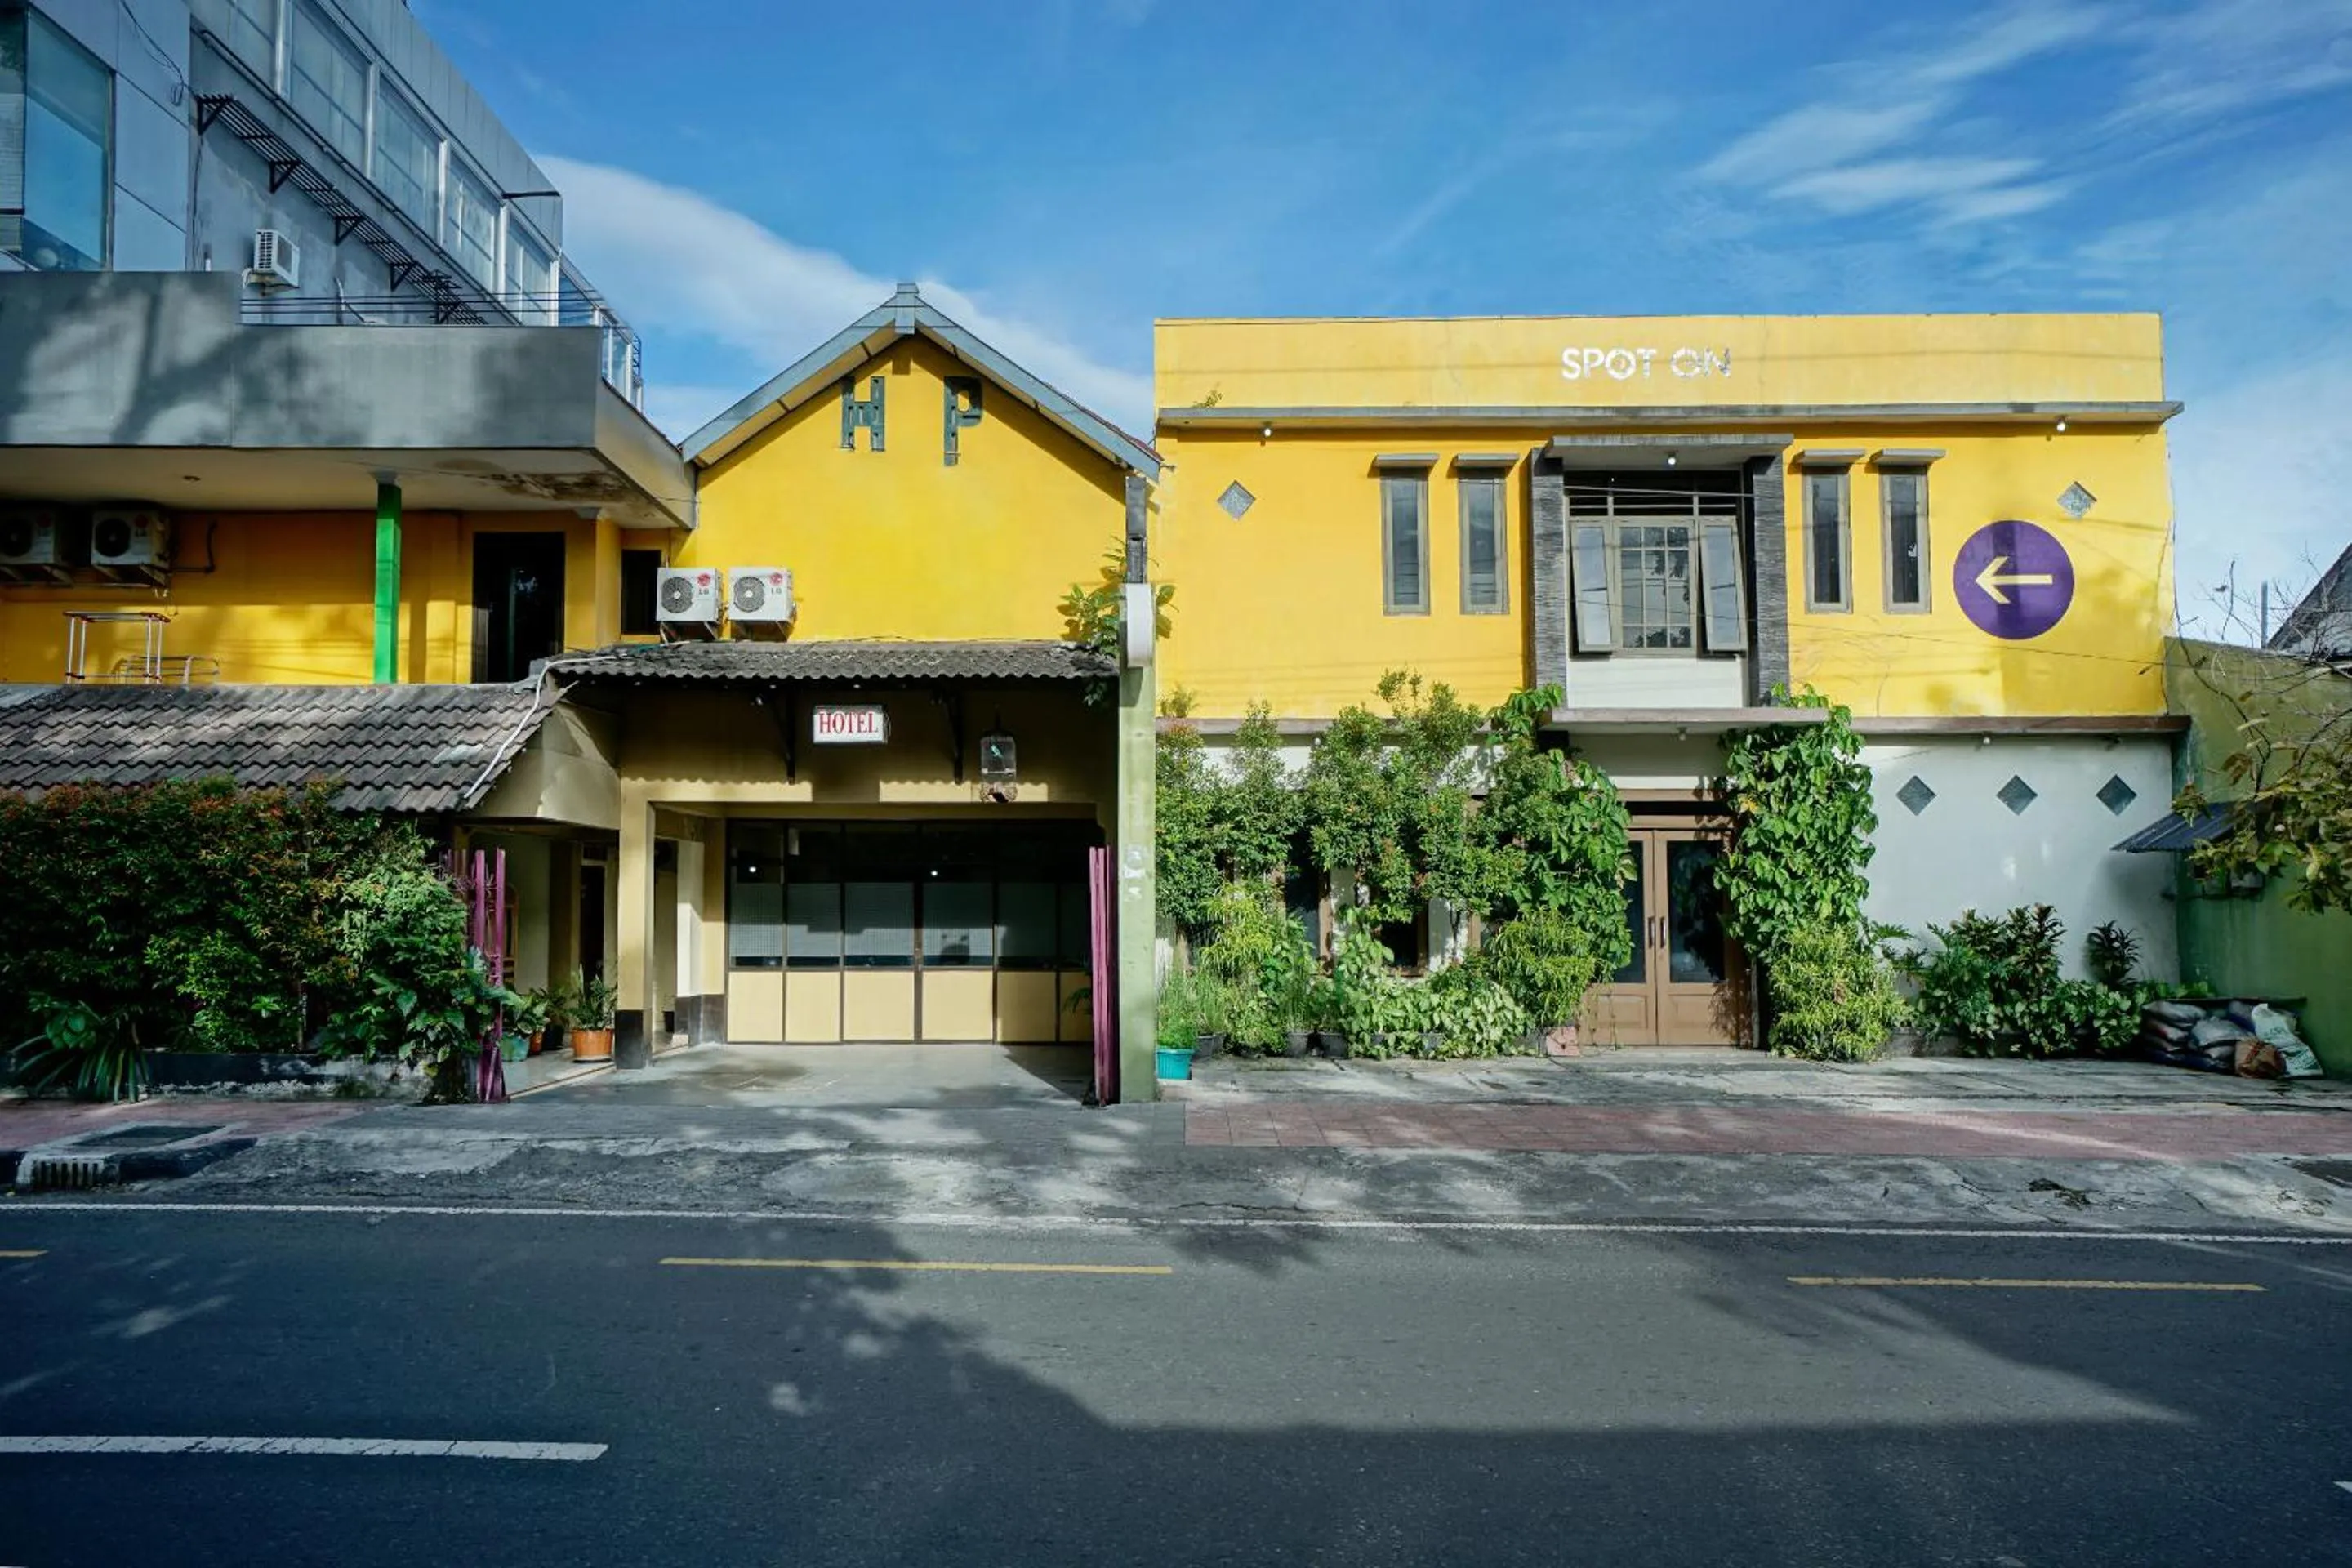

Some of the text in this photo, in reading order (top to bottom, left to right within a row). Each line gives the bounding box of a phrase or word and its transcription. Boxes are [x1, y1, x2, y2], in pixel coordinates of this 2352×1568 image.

[1561, 346, 1731, 380] SPOT ON
[818, 711, 879, 733] HOTEL
